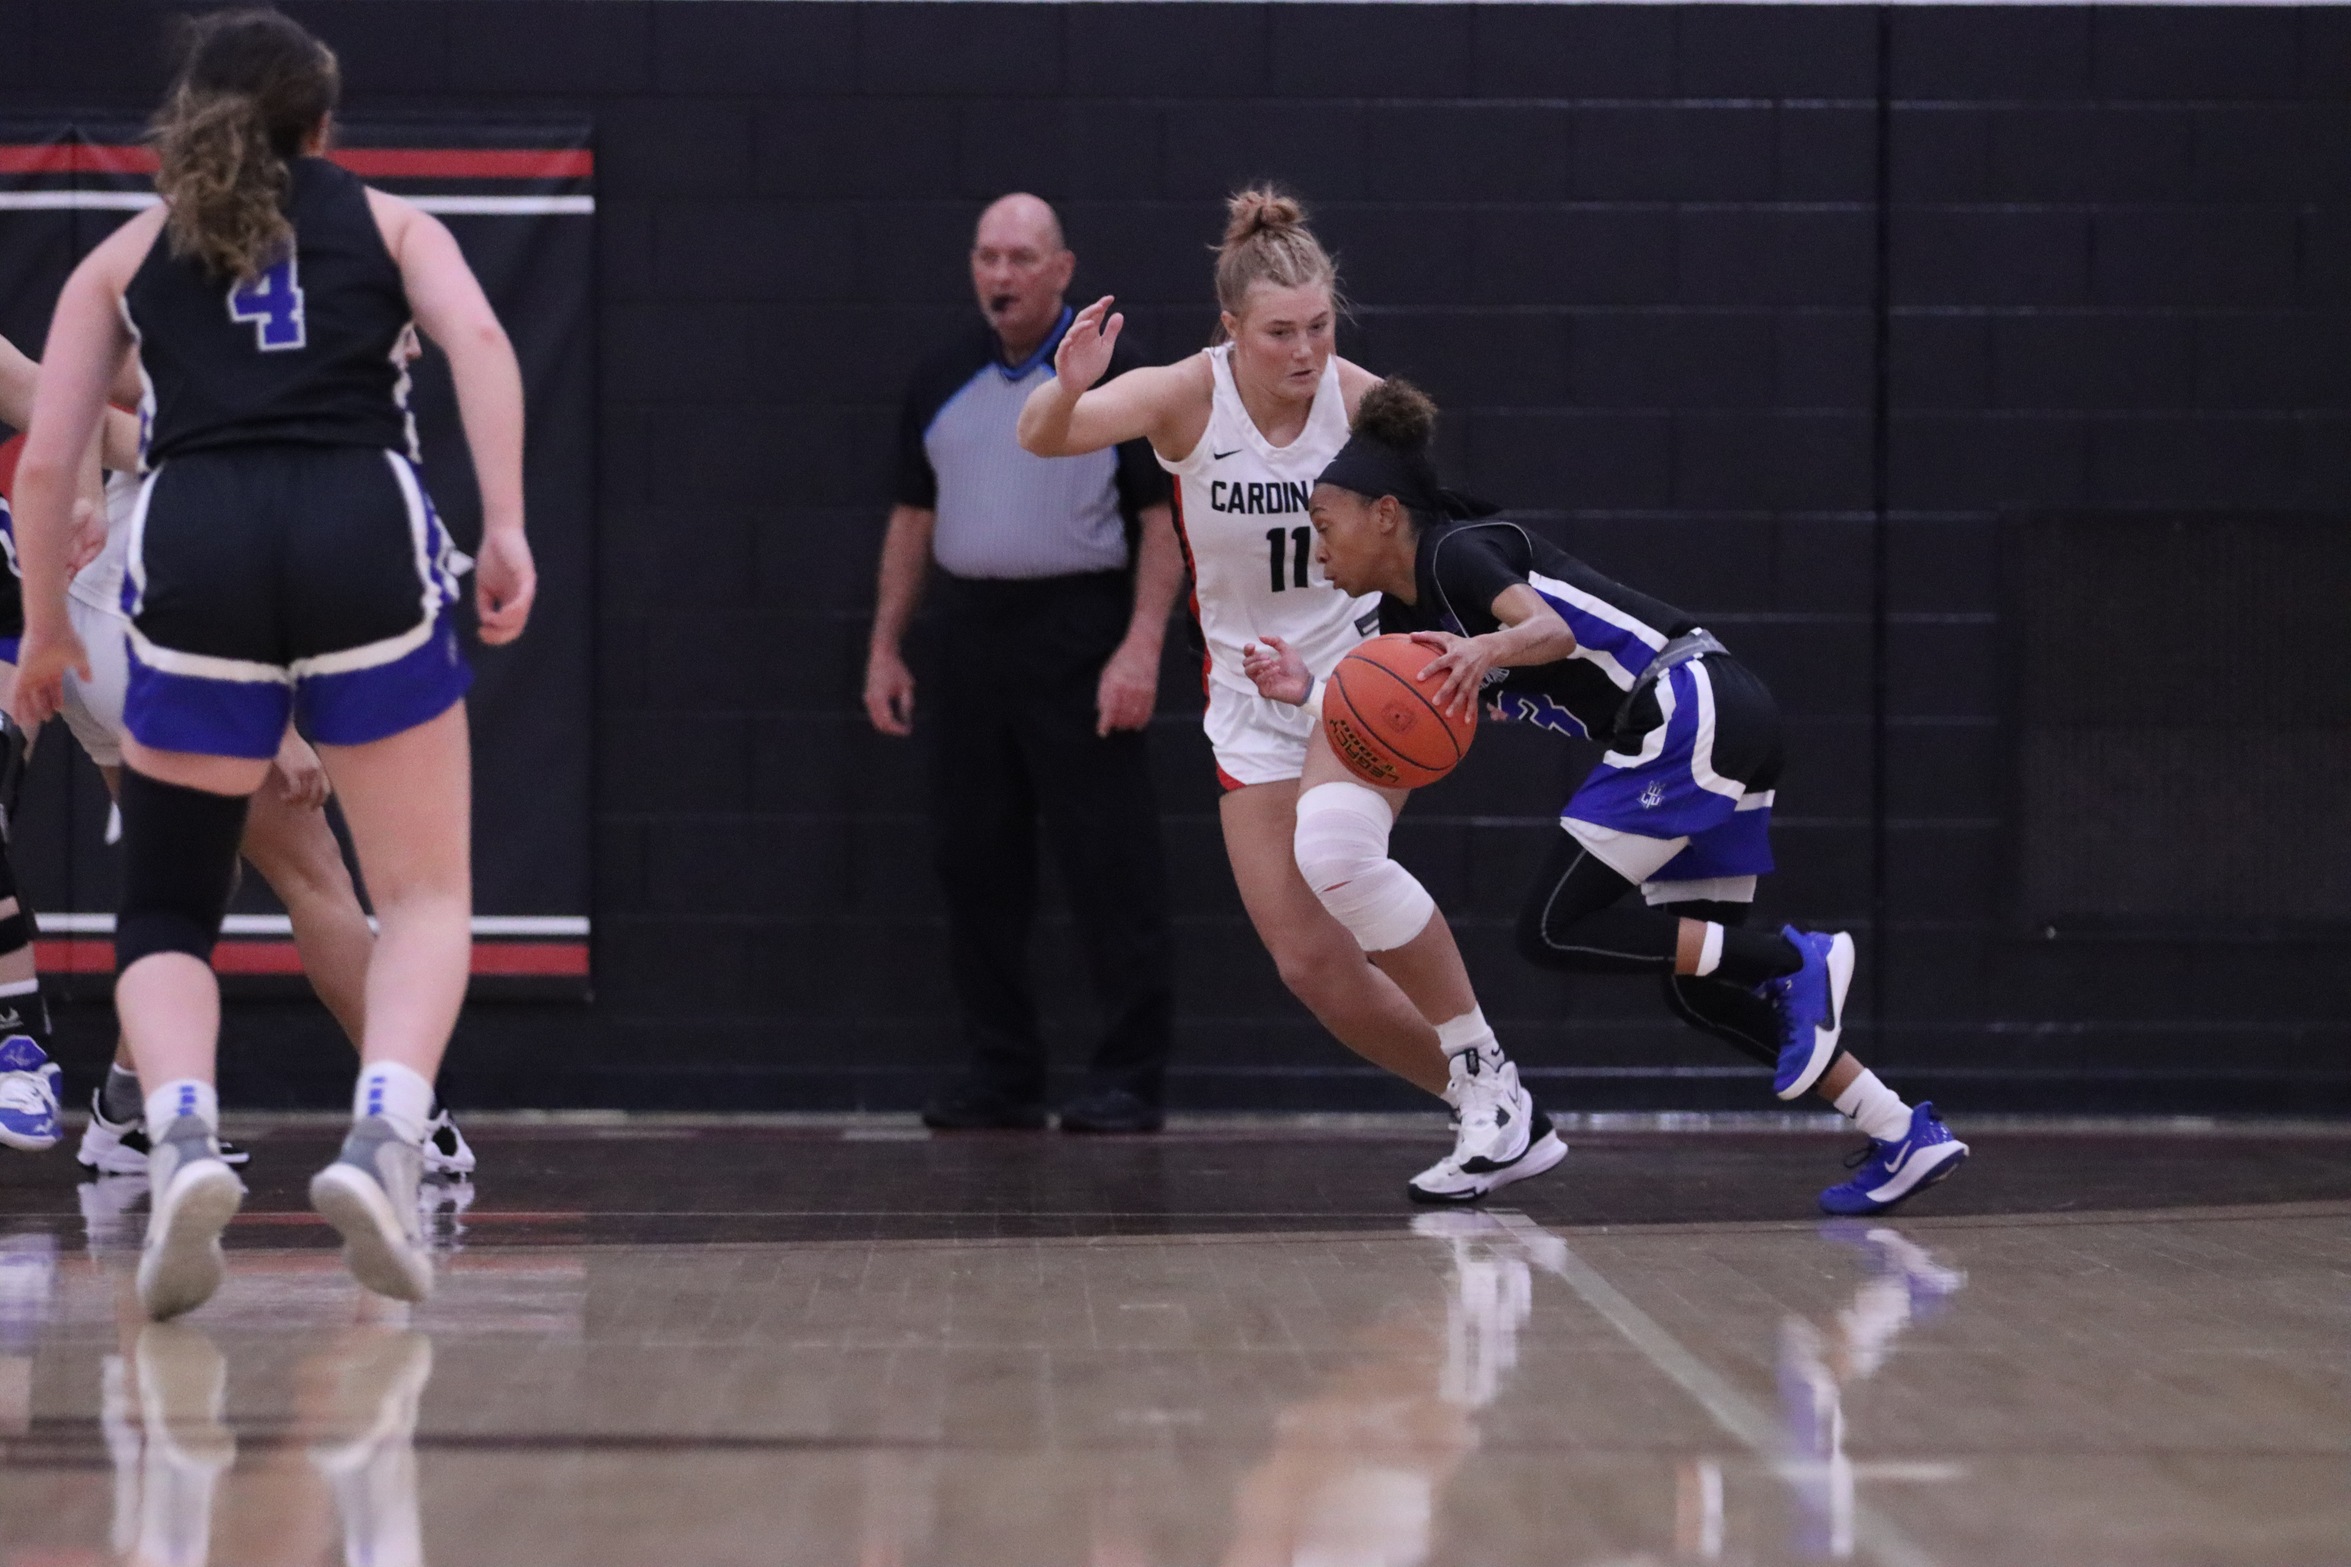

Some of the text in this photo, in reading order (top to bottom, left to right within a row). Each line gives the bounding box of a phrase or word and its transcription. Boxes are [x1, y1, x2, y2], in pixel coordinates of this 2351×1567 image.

[226, 230, 306, 350] 4
[1211, 480, 1310, 514] CARDIN
[1266, 526, 1310, 592] 11
[1330, 719, 1400, 783] LEGACY
